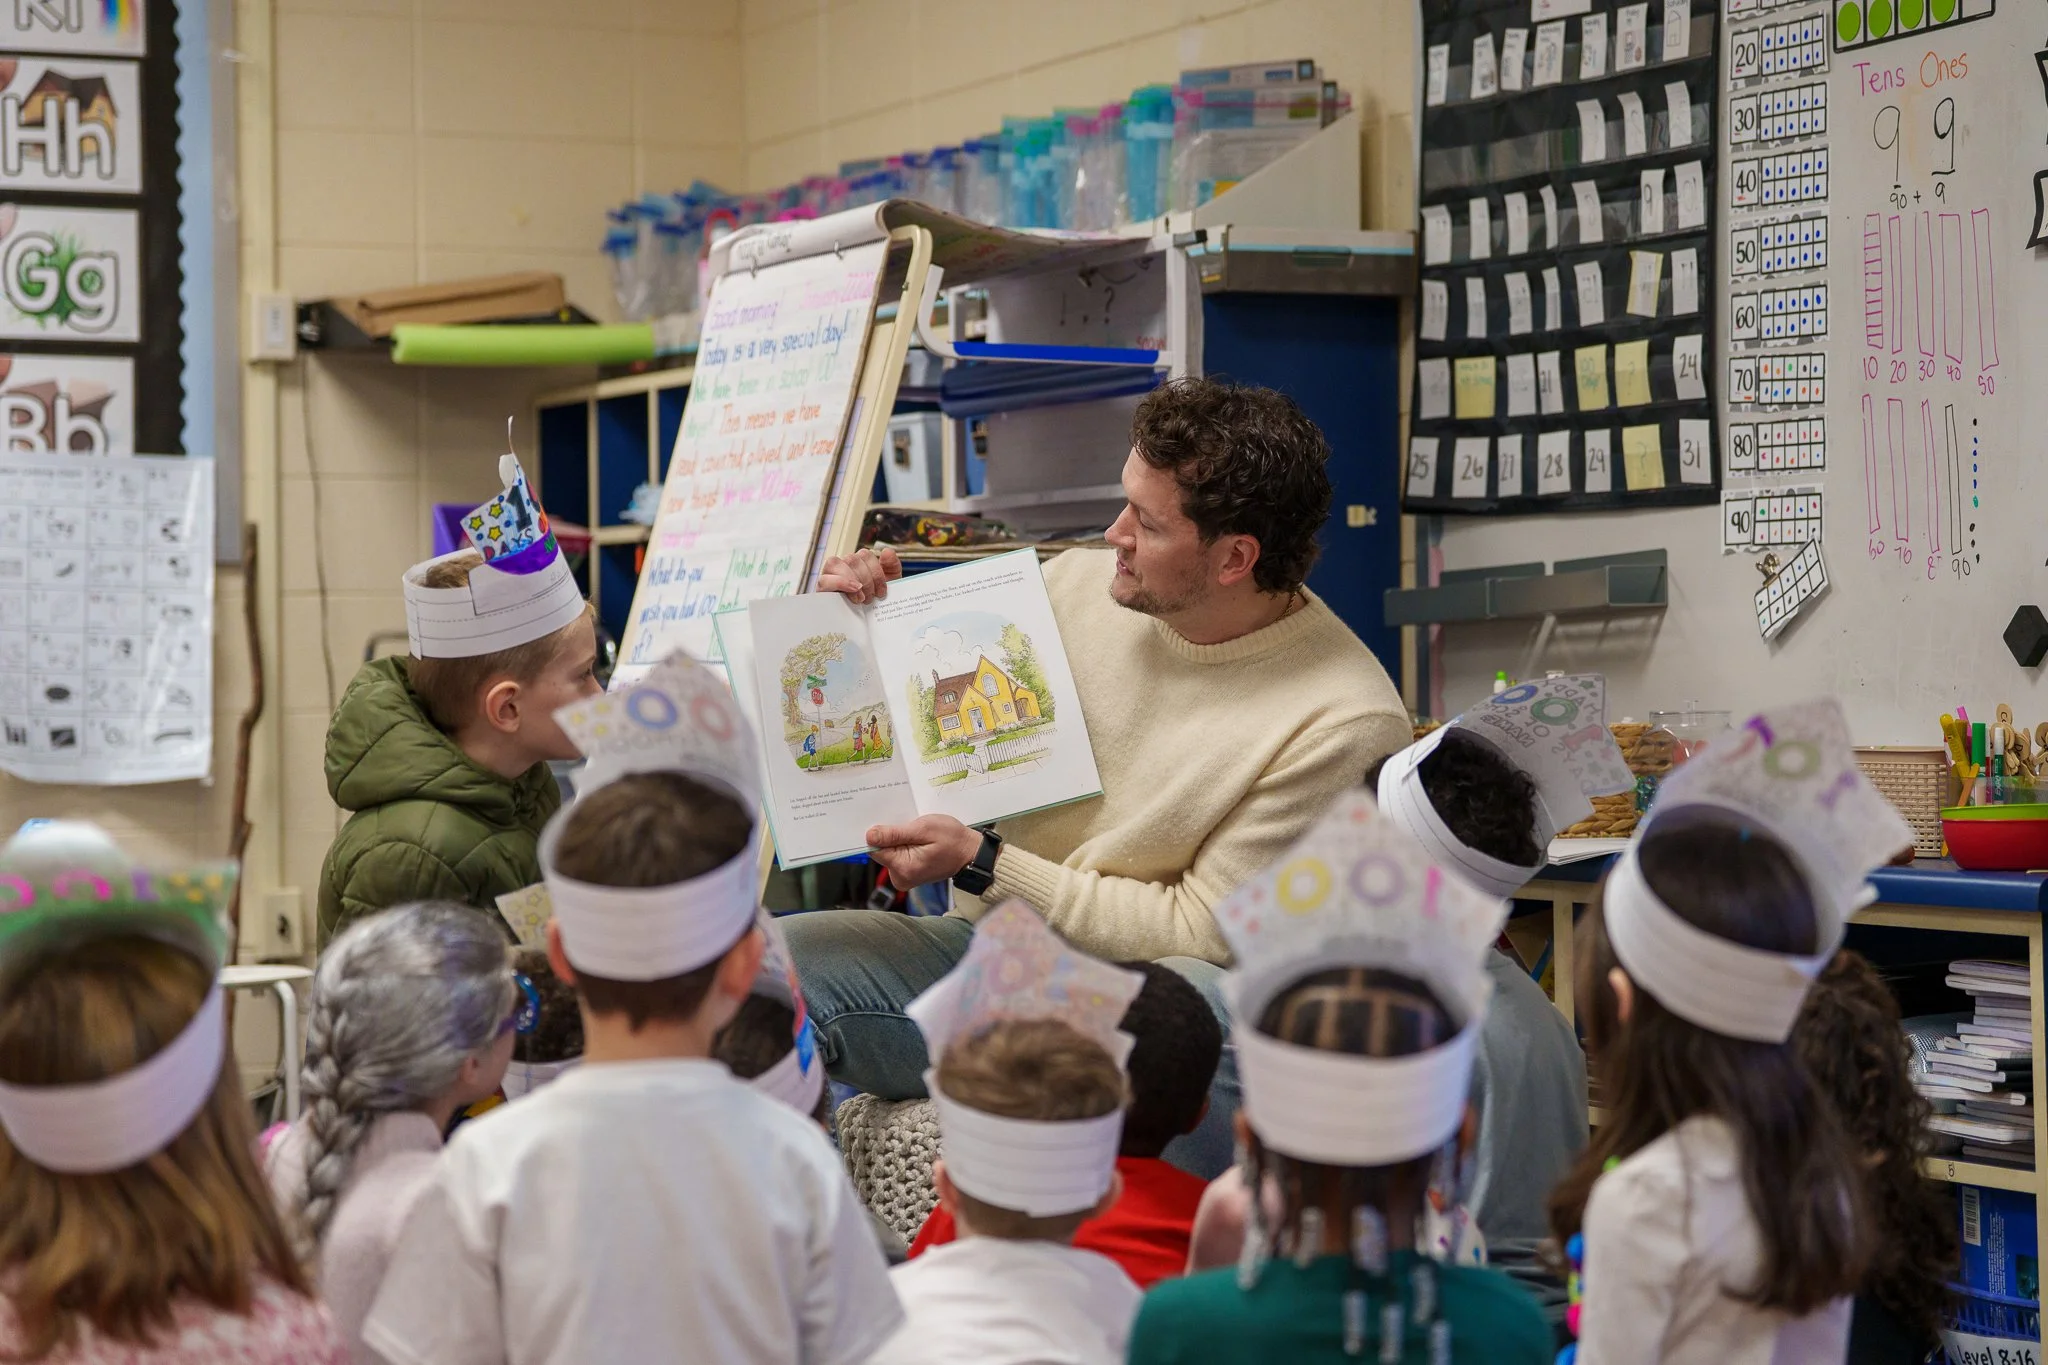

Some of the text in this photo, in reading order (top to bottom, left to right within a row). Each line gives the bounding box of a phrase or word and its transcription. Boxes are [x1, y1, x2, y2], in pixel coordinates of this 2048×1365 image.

[1735, 42, 1756, 68] 20
[1852, 51, 1969, 97] Tens Ones
[1734, 108, 1755, 133] 30
[2, 96, 115, 179] Hh
[1736, 169, 1757, 195] 40
[1889, 192, 1908, 210] 90
[1934, 181, 1946, 205] 9
[1736, 240, 1756, 265] 50
[2, 231, 120, 333] Gg
[1735, 305, 1755, 329] 60
[704, 335, 728, 374] Today
[732, 344, 742, 362] is
[748, 339, 756, 359] a
[759, 339, 777, 364] very
[780, 315, 822, 359] special
[1679, 352, 1698, 380] 24
[1733, 368, 1754, 392] 70
[1863, 356, 1995, 396] 10 20 30 40 50
[1733, 433, 1753, 458] 80
[1410, 453, 1429, 480] 25
[1460, 454, 1484, 481] 26
[1543, 453, 1563, 479] 28
[1588, 447, 1606, 474] 29
[1682, 439, 1701, 470] 31
[1731, 510, 1751, 534] 90
[648, 555, 704, 600] What do you
[733, 551, 756, 579] What
[758, 549, 768, 571] do
[1951, 556, 1971, 581] 90
[661, 602, 678, 632] you
[1957, 1344, 2036, 1365] Level 8-16
